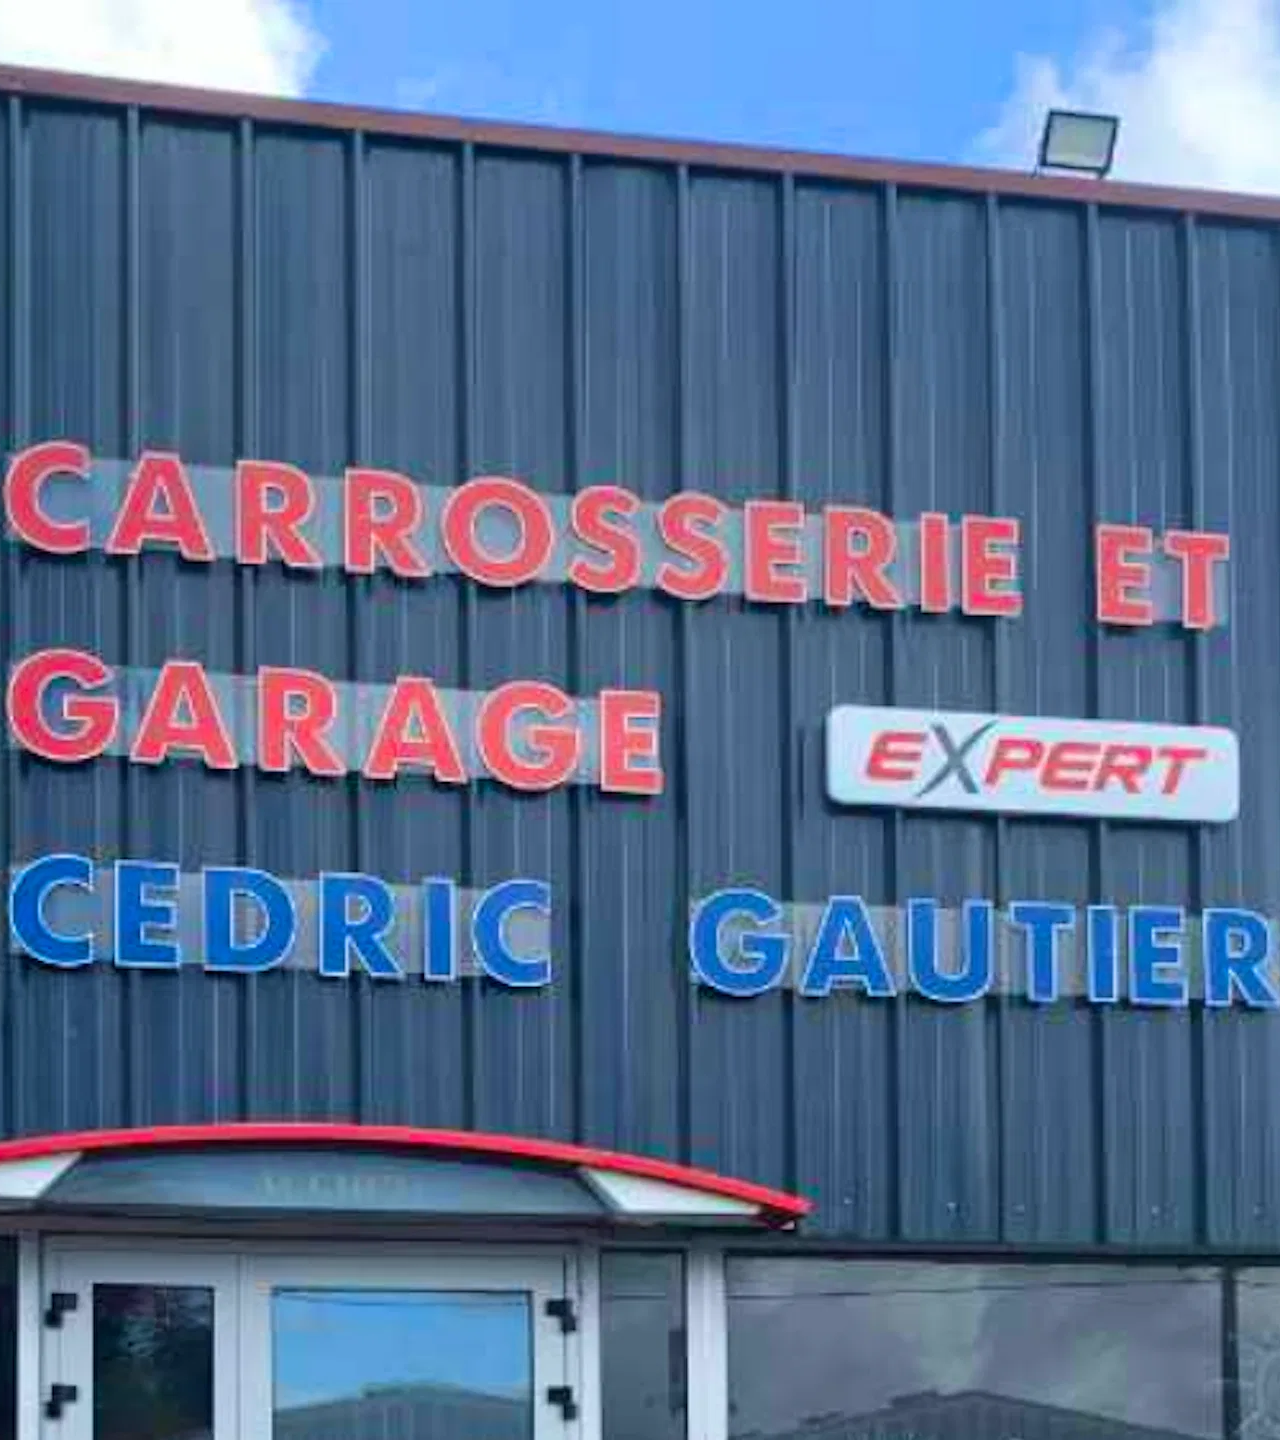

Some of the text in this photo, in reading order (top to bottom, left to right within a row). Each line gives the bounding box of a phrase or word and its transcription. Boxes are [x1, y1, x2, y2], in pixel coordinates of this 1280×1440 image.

[4, 441, 1231, 631] CARROSSERIE ET
[6, 648, 664, 796] GARAGE
[865, 719, 1208, 798] EXPERT
[8, 852, 1280, 1008] CEDRIC GAUTIER
